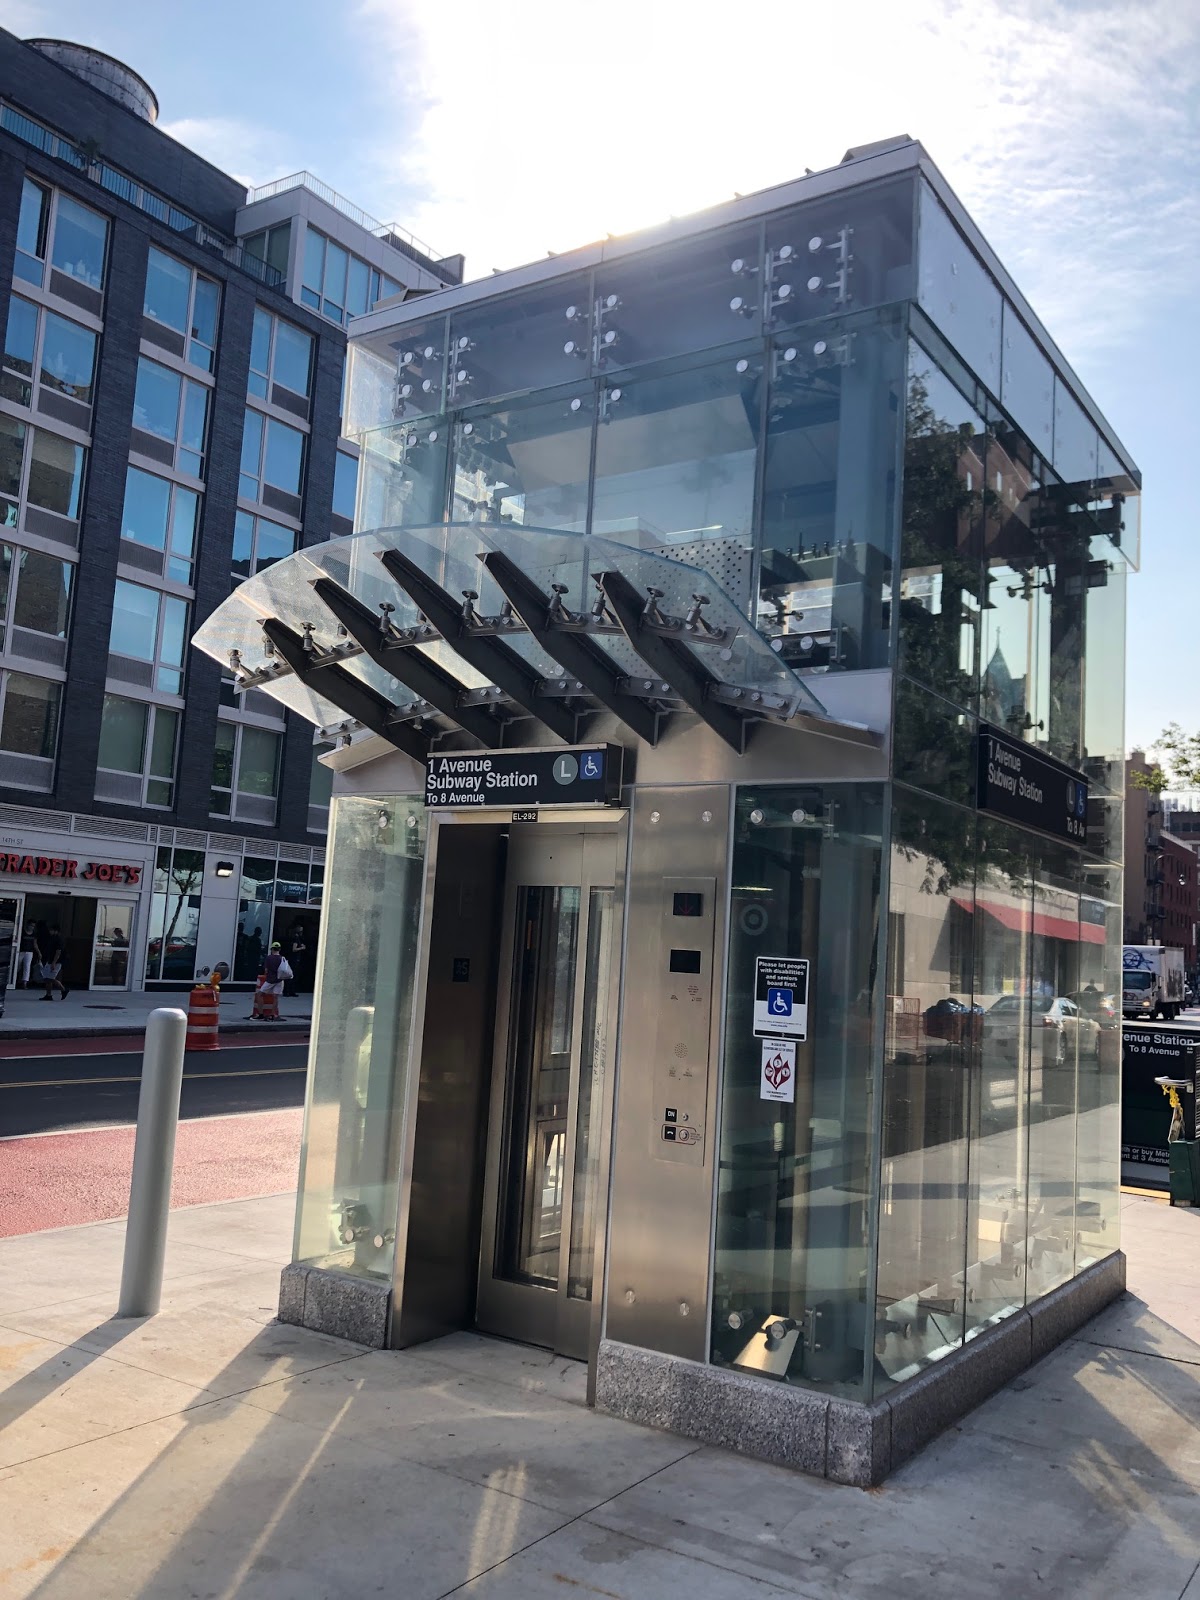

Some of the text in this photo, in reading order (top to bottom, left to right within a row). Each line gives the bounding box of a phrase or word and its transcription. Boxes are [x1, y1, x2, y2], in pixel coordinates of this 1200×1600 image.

[988, 740, 1021, 772] 1 Avenue
[428, 758, 492, 773] 1 Avenue
[561, 760, 571, 778] L
[427, 771, 538, 792] Subway Station
[988, 762, 1043, 803] Subway Station
[427, 792, 485, 803] To 8 Avenue
[513, 812, 536, 820] EL-292
[1066, 817, 1073, 833] To
[1073, 820, 1078, 835] 8
[81, 862, 142, 885] JOE'S
[1122, 1033, 1194, 1046] enue Station
[1129, 1044, 1139, 1053] To
[1141, 1045, 1147, 1053] 8
[1148, 1046, 1180, 1057] Avenue
